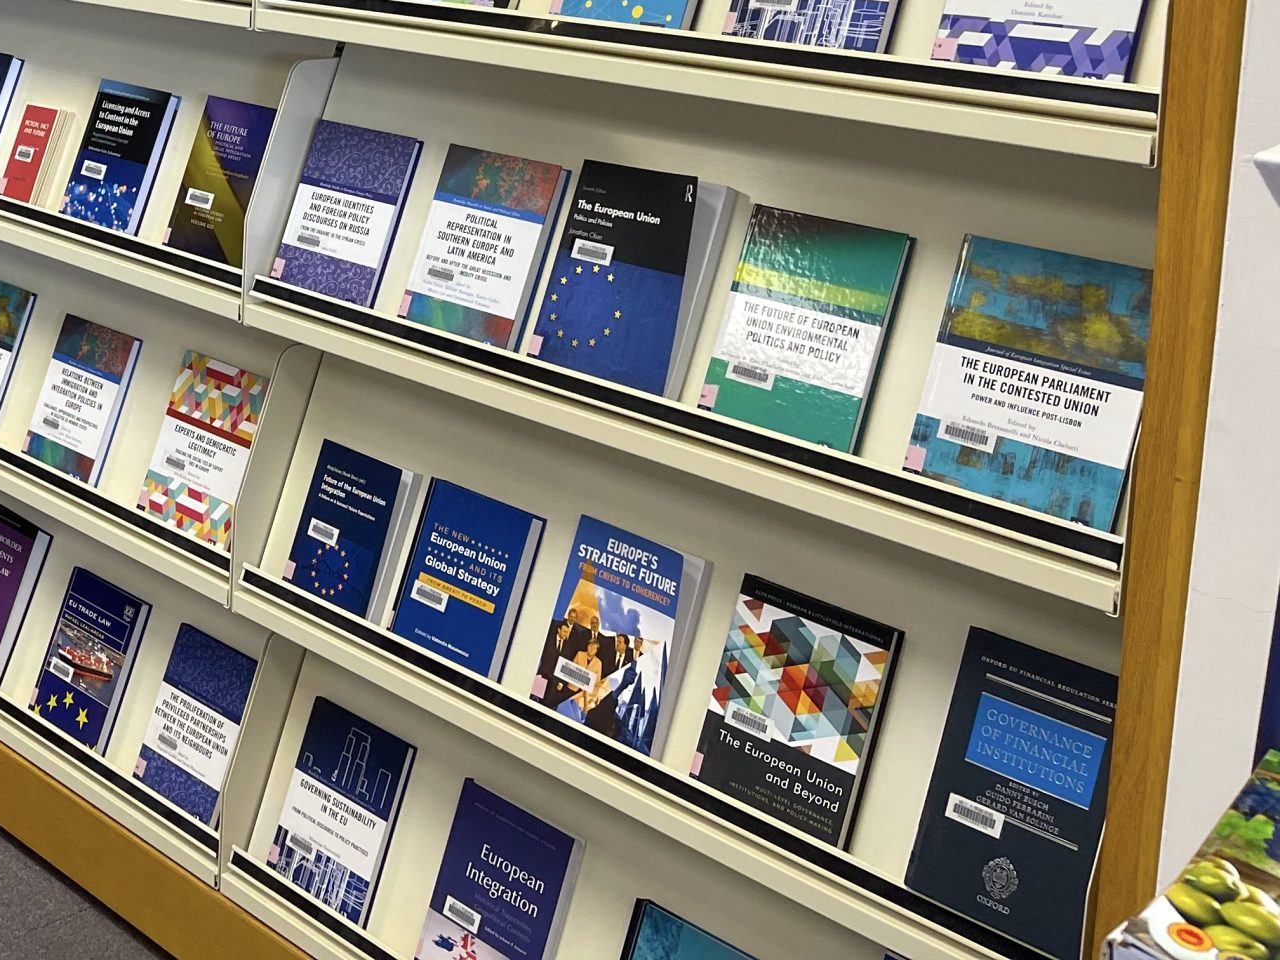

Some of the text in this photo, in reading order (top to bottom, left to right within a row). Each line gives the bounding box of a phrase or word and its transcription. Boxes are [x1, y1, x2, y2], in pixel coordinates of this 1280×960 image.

[309, 203, 370, 225] AND FOREIGN POLICY
[311, 191, 374, 214] EUROPEAN IDENTITIES
[578, 200, 661, 225] The European Union
[302, 212, 370, 236] DISCOURSES ON RUSSIA
[446, 221, 512, 244] REPRESENTATION IN
[465, 213, 498, 229] POLITICAL
[437, 231, 514, 257] SOUTHERN EUROPE AND
[447, 246, 496, 266] LATIN AMERICA
[744, 301, 860, 339] THE FUTURE OF EUROPEAN
[746, 316, 848, 352] UNION ENVIRONMENTAL
[746, 330, 842, 363] POLITICS AND POLICY
[961, 356, 1112, 404] THE EUROPEAN PARLIAMENT
[963, 373, 1099, 417] IN THE CONTESTED UNION
[971, 393, 1082, 428] POWER AND INFLUENCE POST-LISBON
[320, 483, 346, 499] Integration
[323, 474, 386, 507] Future of the European Union
[434, 522, 470, 543] THE NEW
[430, 532, 507, 572] European Union
[607, 538, 659, 569] EUROPE'S
[424, 555, 500, 597] Global Strategy
[469, 563, 504, 583] AND ITS
[578, 544, 677, 596] STRATEGIC FUTURE
[578, 561, 671, 606] FROM CRISIS TO COHERENCE?
[69, 599, 112, 628] EU TRADE LAW
[981, 725, 1088, 776] OF FINANCIAL
[986, 709, 1093, 758] GOVERNANCE
[720, 729, 844, 797] The European Union
[976, 741, 1085, 793] INSTITUTIONS
[300, 778, 377, 830] GOVERNING SUSTAINABILITY
[765, 771, 839, 813] and Beyond
[321, 804, 348, 826] IN THE EU
[480, 843, 545, 894] European
[465, 861, 538, 919] Integration
[976, 894, 1010, 915] OXFORD
